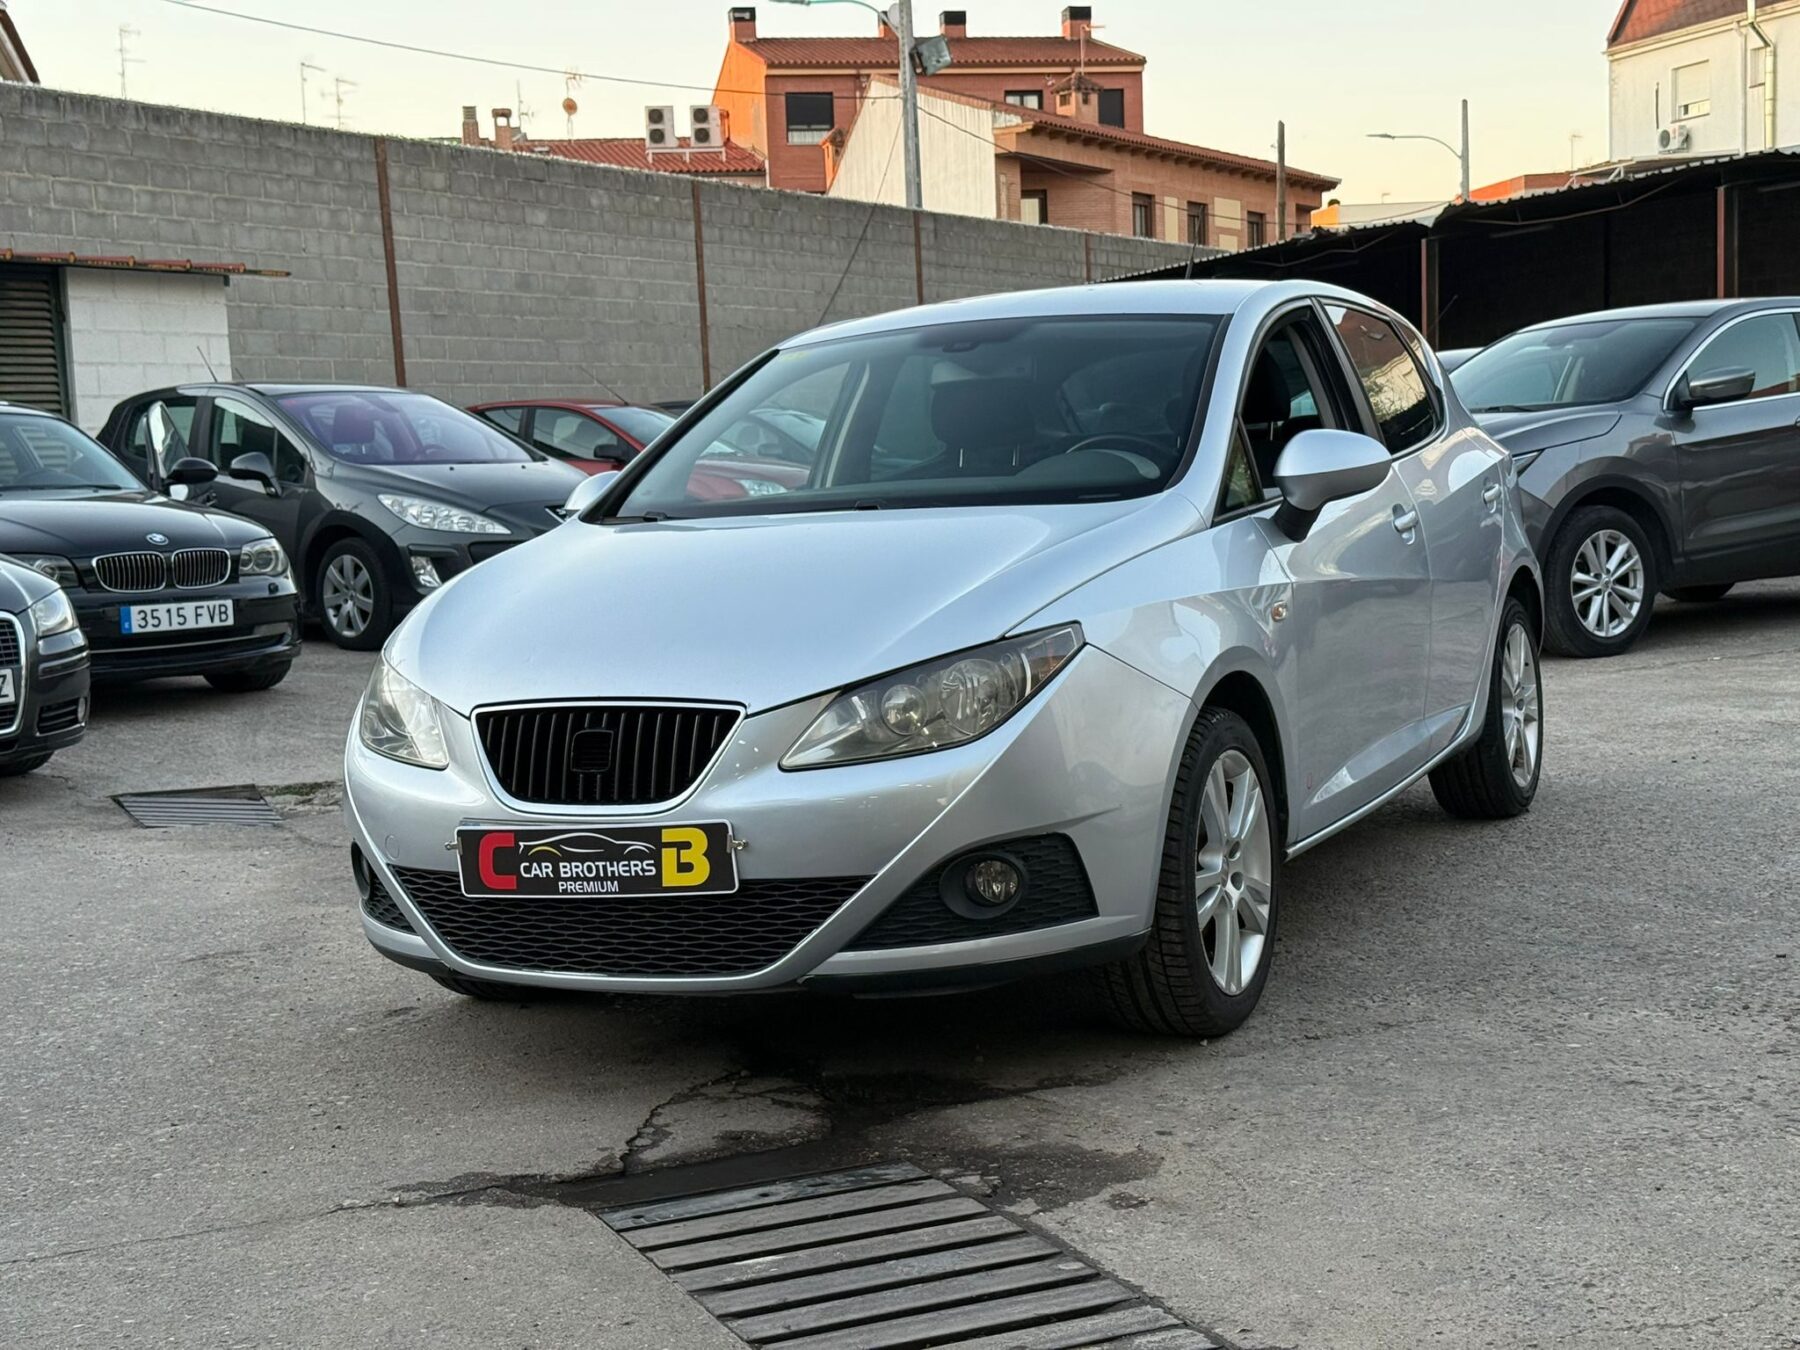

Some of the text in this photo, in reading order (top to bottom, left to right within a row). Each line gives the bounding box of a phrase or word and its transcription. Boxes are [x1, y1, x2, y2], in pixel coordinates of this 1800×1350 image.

[137, 604, 229, 629] 3515 FVB
[479, 832, 517, 889] C
[520, 860, 657, 878] CAR BROTHERS
[661, 827, 711, 887] B
[558, 880, 619, 893] PREMIUM
